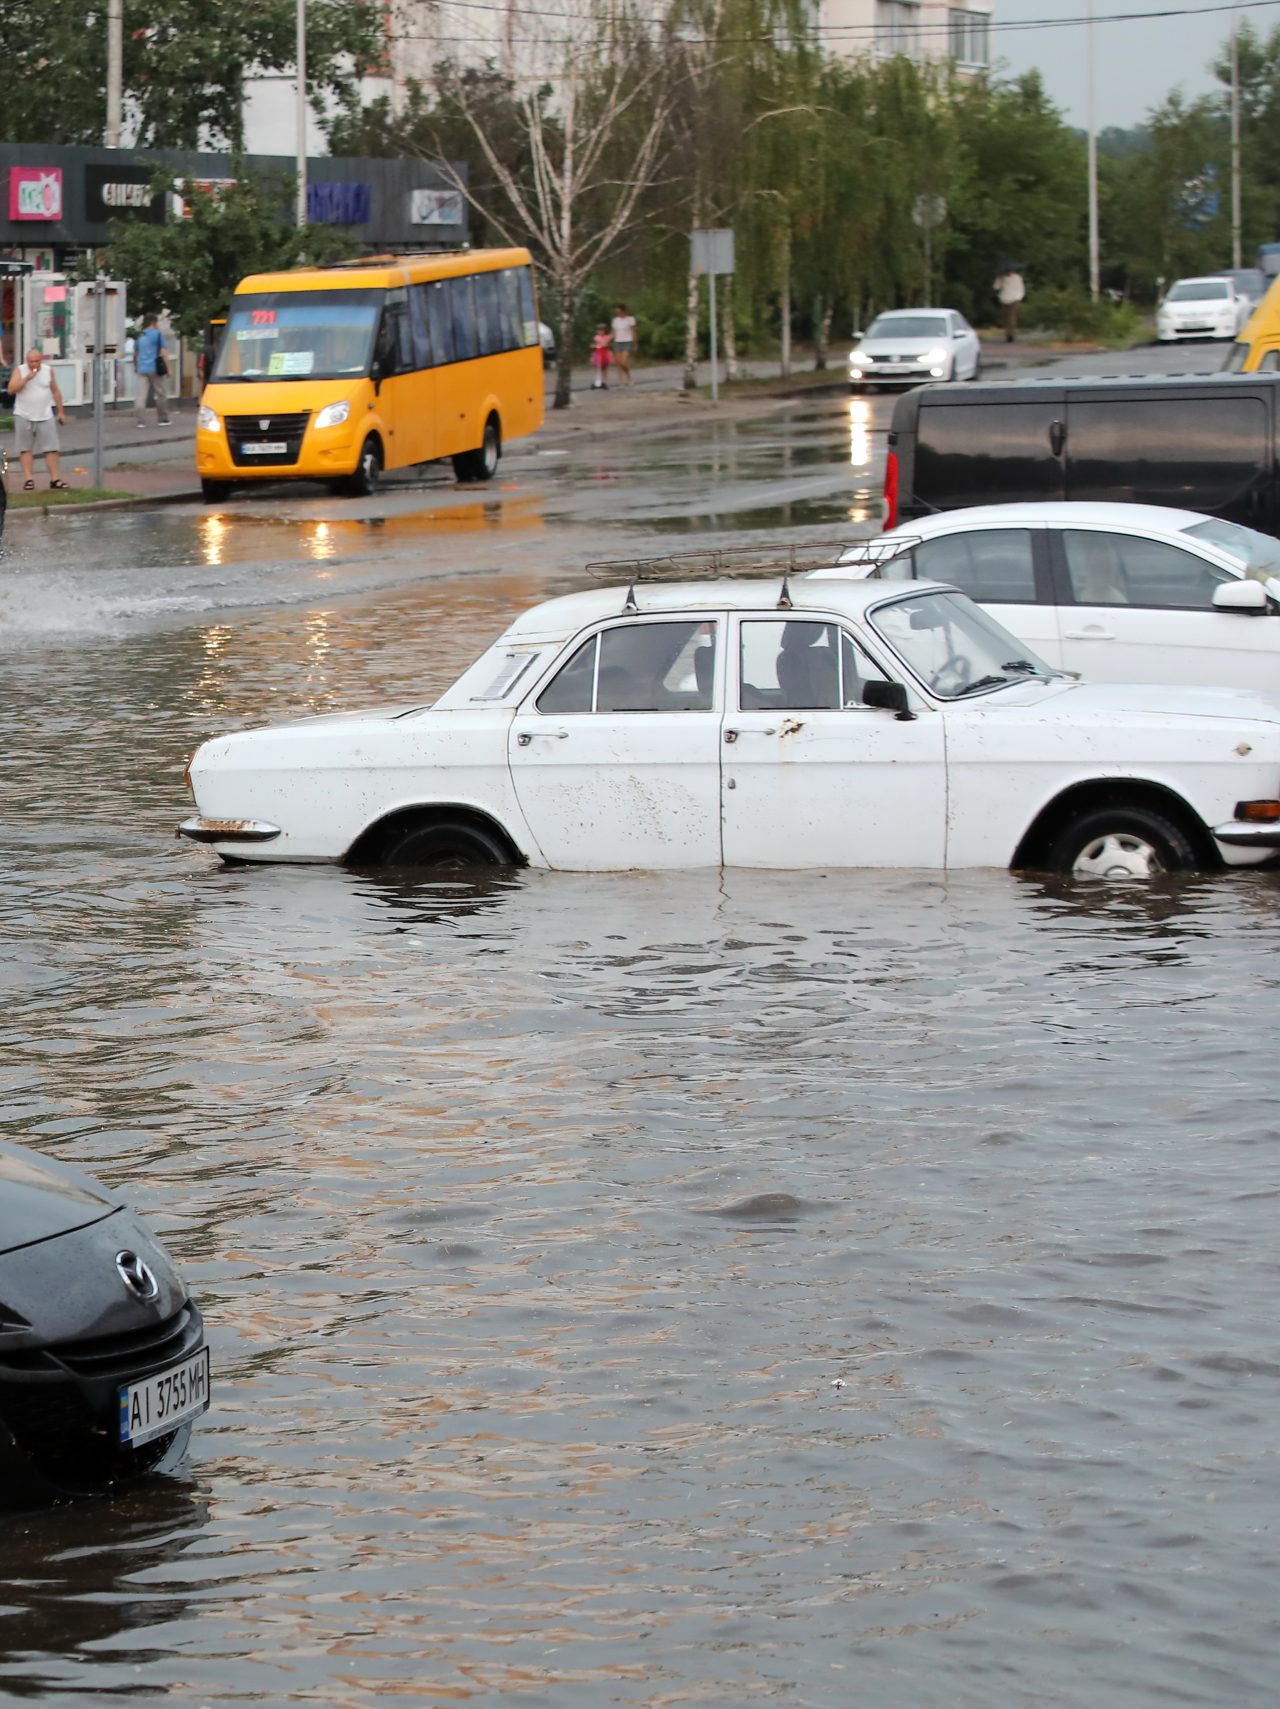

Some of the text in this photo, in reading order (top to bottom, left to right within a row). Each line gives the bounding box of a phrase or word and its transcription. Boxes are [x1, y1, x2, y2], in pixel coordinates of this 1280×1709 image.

[131, 1386, 150, 1431] AI
[157, 1369, 187, 1419] 3755
[189, 1359, 206, 1404] MH
